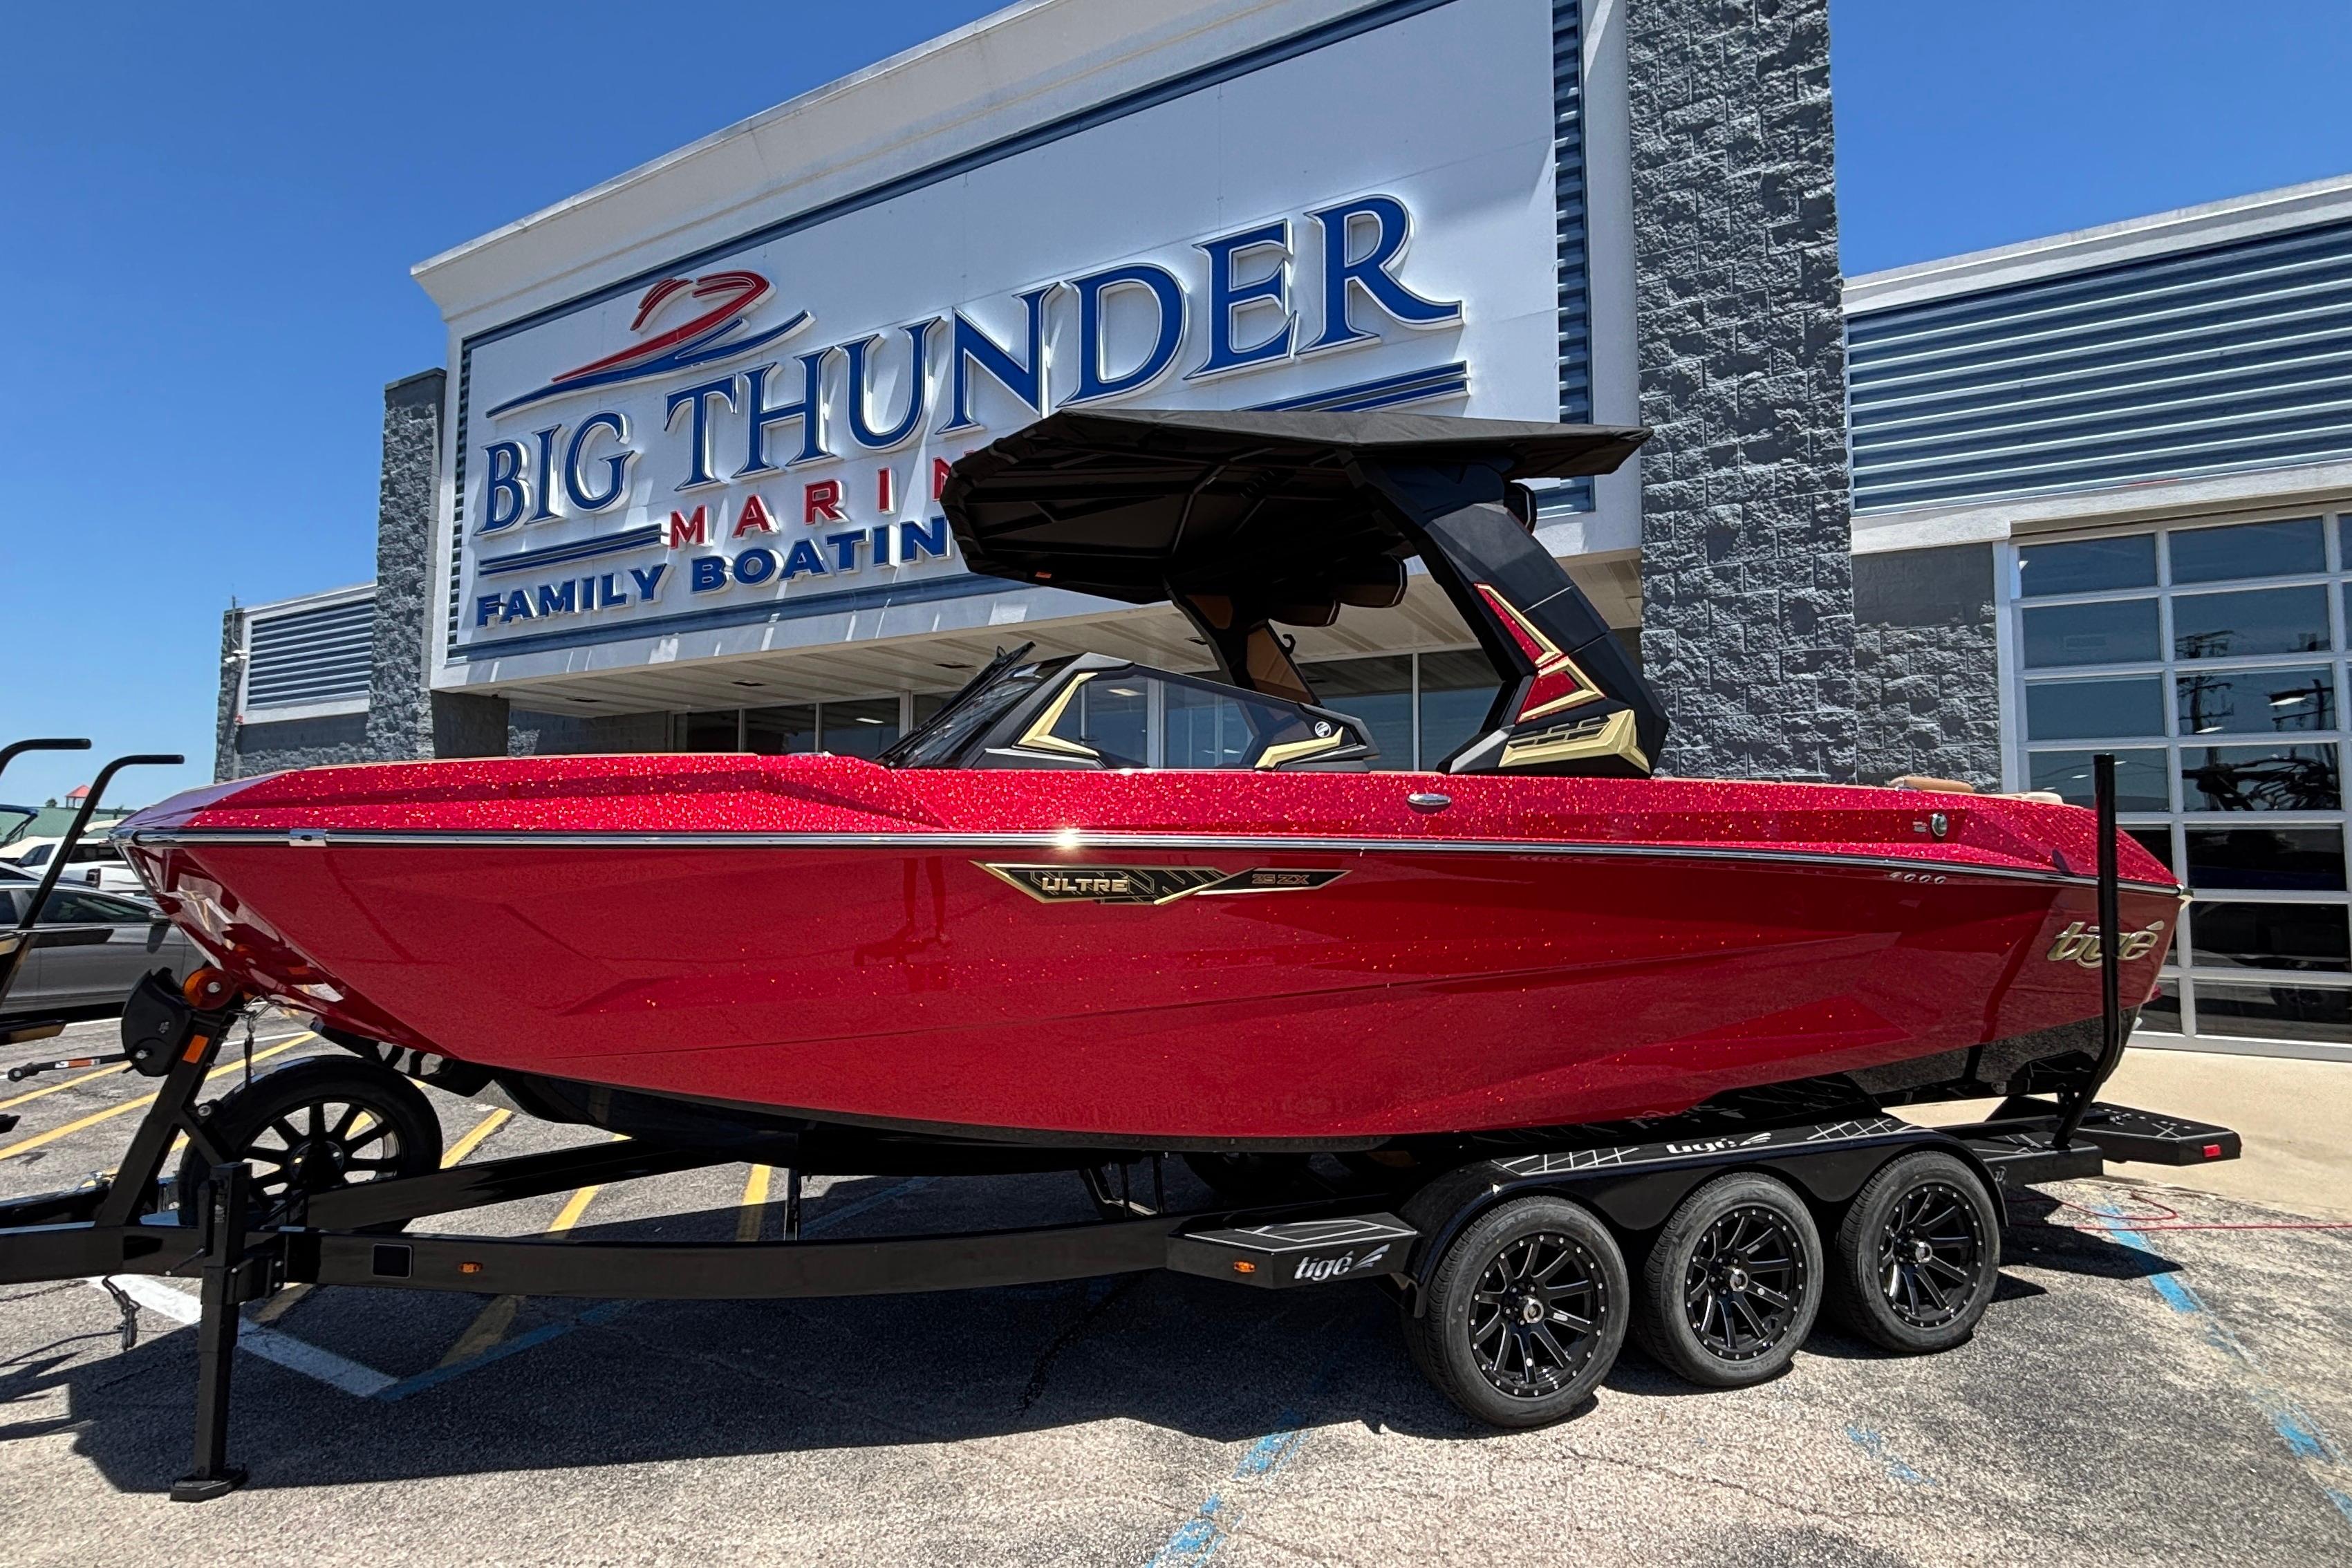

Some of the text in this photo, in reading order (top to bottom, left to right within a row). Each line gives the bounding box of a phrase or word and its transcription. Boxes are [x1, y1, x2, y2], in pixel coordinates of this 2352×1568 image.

[474, 194, 1463, 537] BIG THUNDER
[669, 450, 973, 550] MARIN
[476, 514, 949, 627] FAMILY BOATIN
